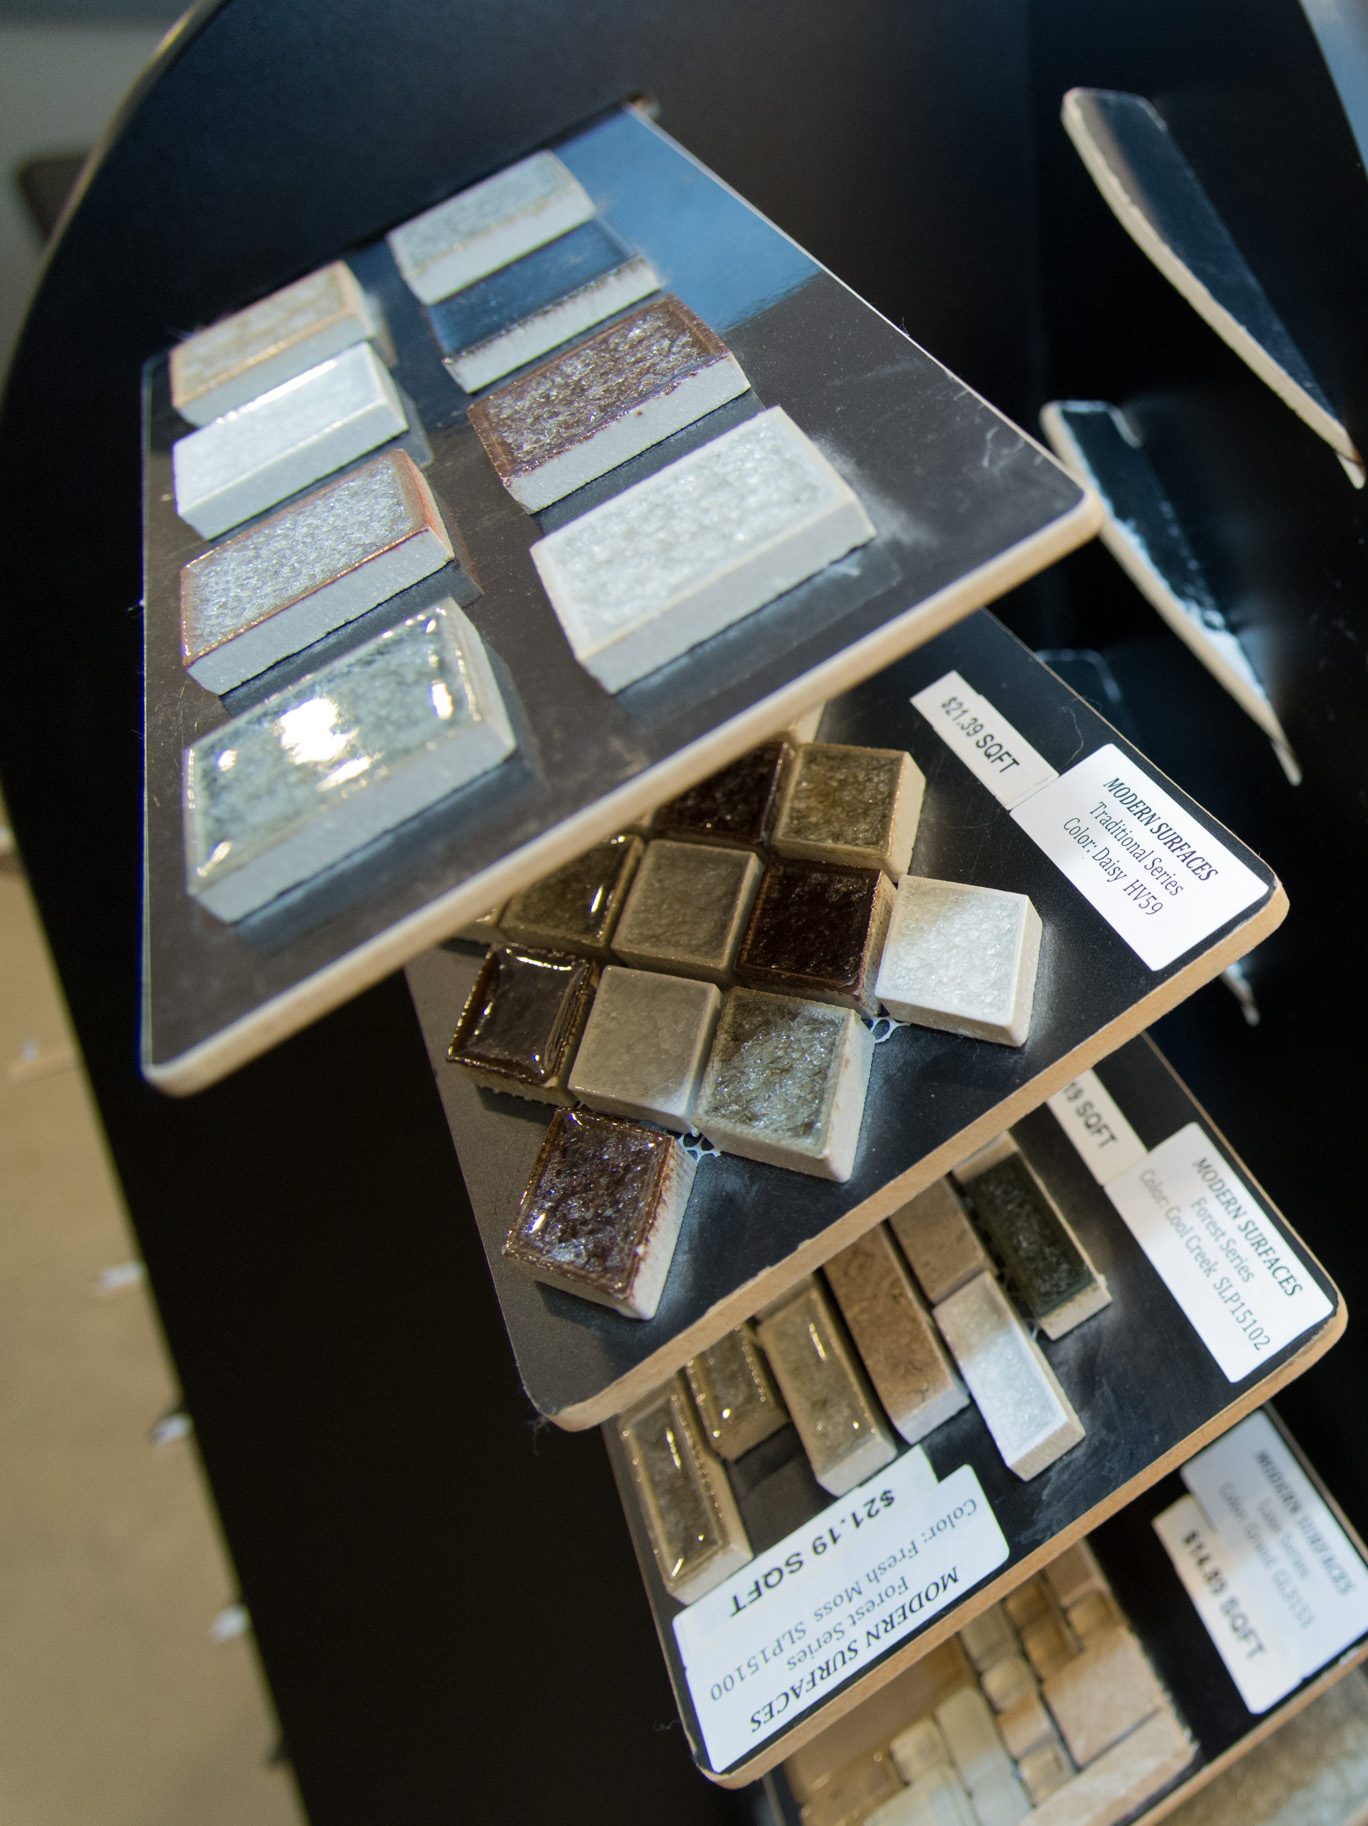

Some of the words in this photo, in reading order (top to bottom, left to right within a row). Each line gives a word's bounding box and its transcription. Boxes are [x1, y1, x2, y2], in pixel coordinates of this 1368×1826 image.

[941, 696, 984, 739] $21.39
[975, 733, 1021, 775] SQFT
[1063, 816, 1098, 853] Color:
[1091, 847, 1127, 893] Daisy
[1123, 879, 1164, 917] HV59
[1089, 801, 1152, 863] Traditional
[1144, 856, 1184, 897] Series
[1103, 777, 1160, 834] MODERN
[1150, 822, 1219, 883] SURFACES
[1075, 1101, 1118, 1149] SQFT
[1140, 1169, 1169, 1210] Color:
[1165, 1206, 1191, 1238] Cool
[1184, 1234, 1219, 1279] Creek
[1213, 1276, 1270, 1351] SLP15102
[1190, 1197, 1227, 1242] Forest
[1220, 1237, 1254, 1282] Series
[1192, 1157, 1246, 1222] MODERN
[1237, 1219, 1303, 1297] SURFACES
[811, 1489, 895, 1555] $21.19
[922, 1498, 977, 1543] Color:
[729, 1552, 804, 1618] SQFT
[866, 1540, 919, 1584] Fresh
[814, 1584, 863, 1622] Moss
[849, 1576, 909, 1628] Forest
[865, 1566, 960, 1648] MODERN
[1220, 1596, 1267, 1658] SQFT
[710, 1621, 806, 1702] SLP15100
[786, 1621, 846, 1671] Series
[749, 1639, 859, 1733] SURFACES
